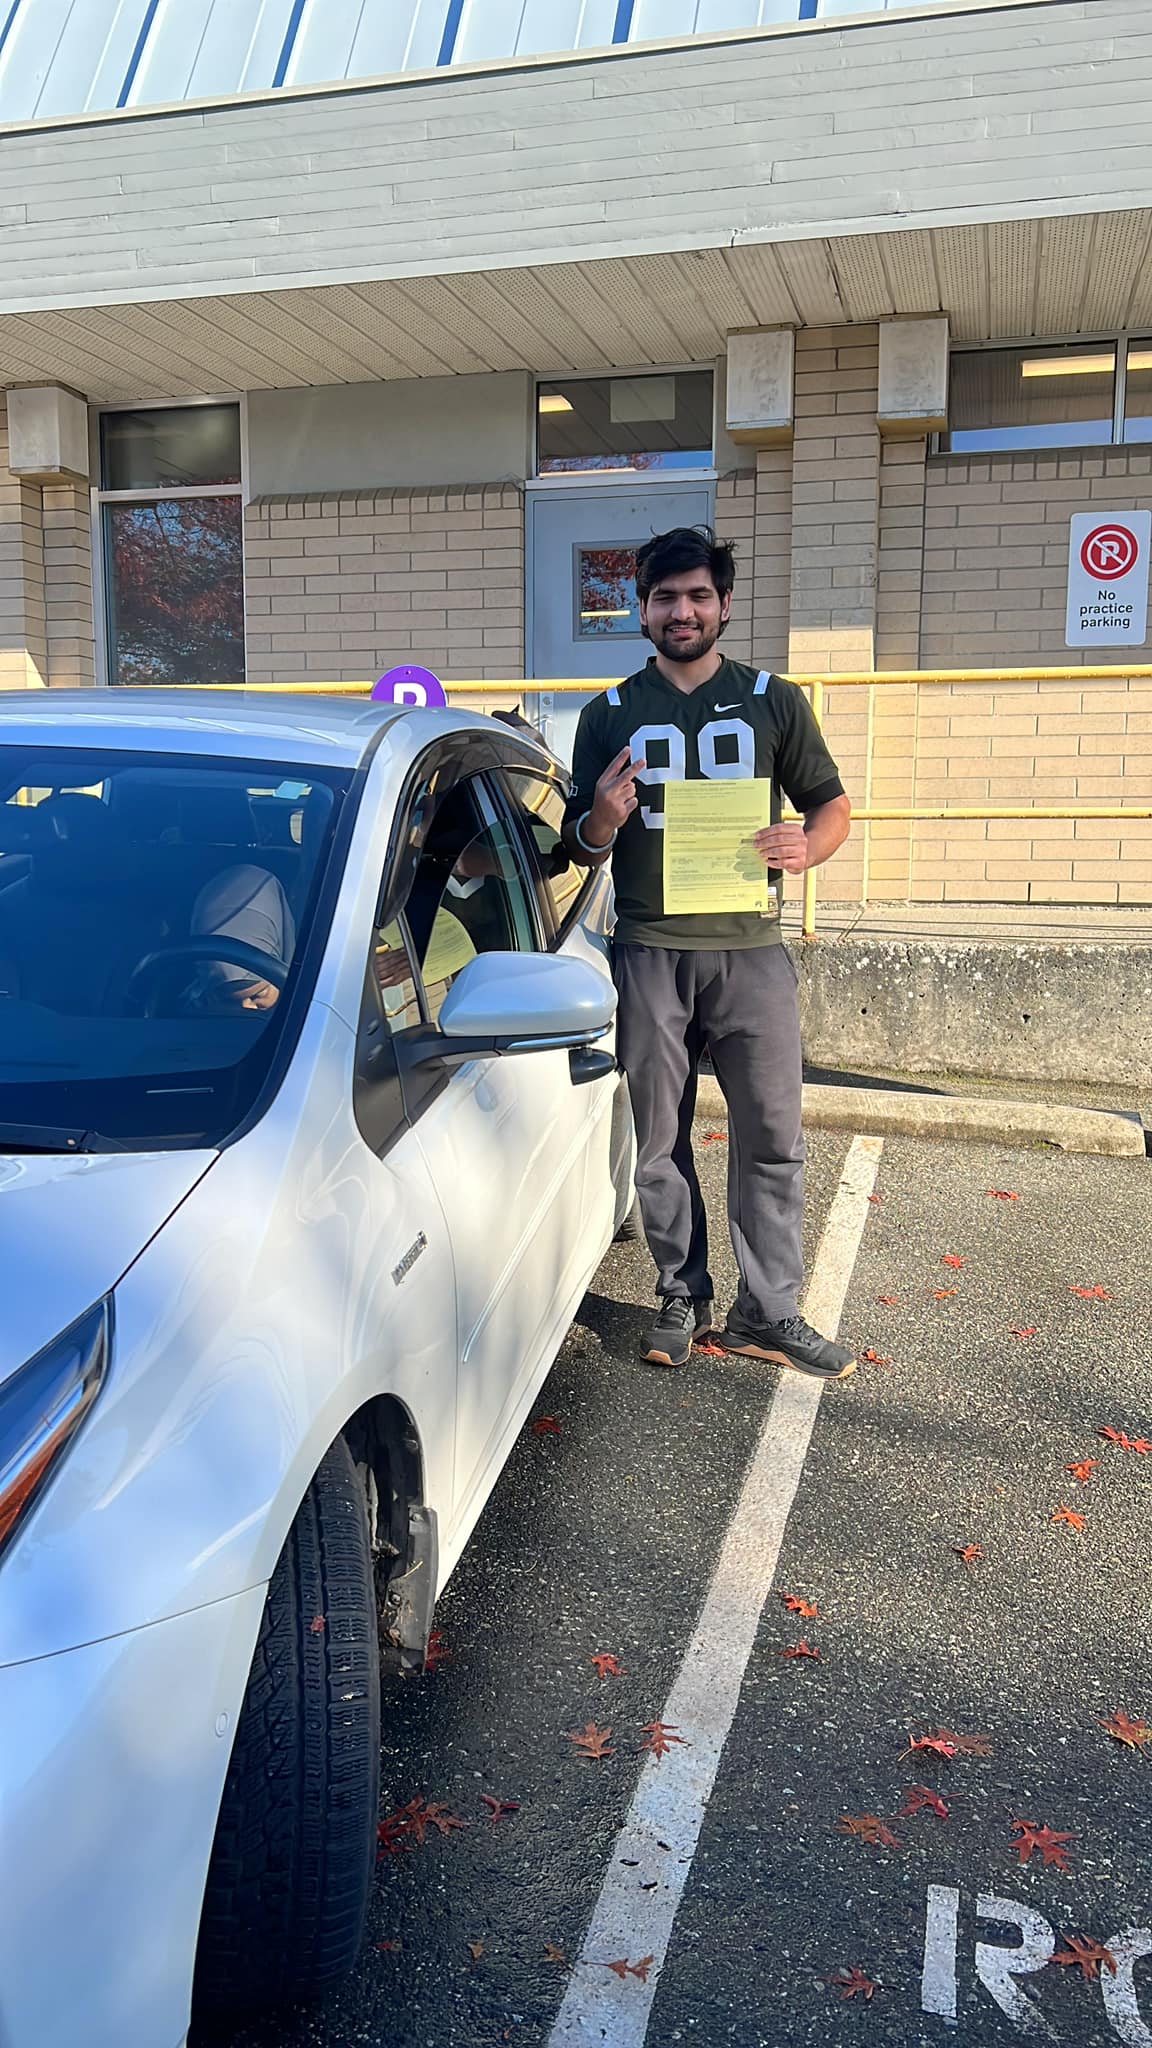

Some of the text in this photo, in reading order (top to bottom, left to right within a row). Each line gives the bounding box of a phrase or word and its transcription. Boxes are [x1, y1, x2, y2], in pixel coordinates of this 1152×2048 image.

[1098, 590, 1116, 601] No
[1079, 603, 1133, 617] practice
[1080, 616, 1131, 630] parking
